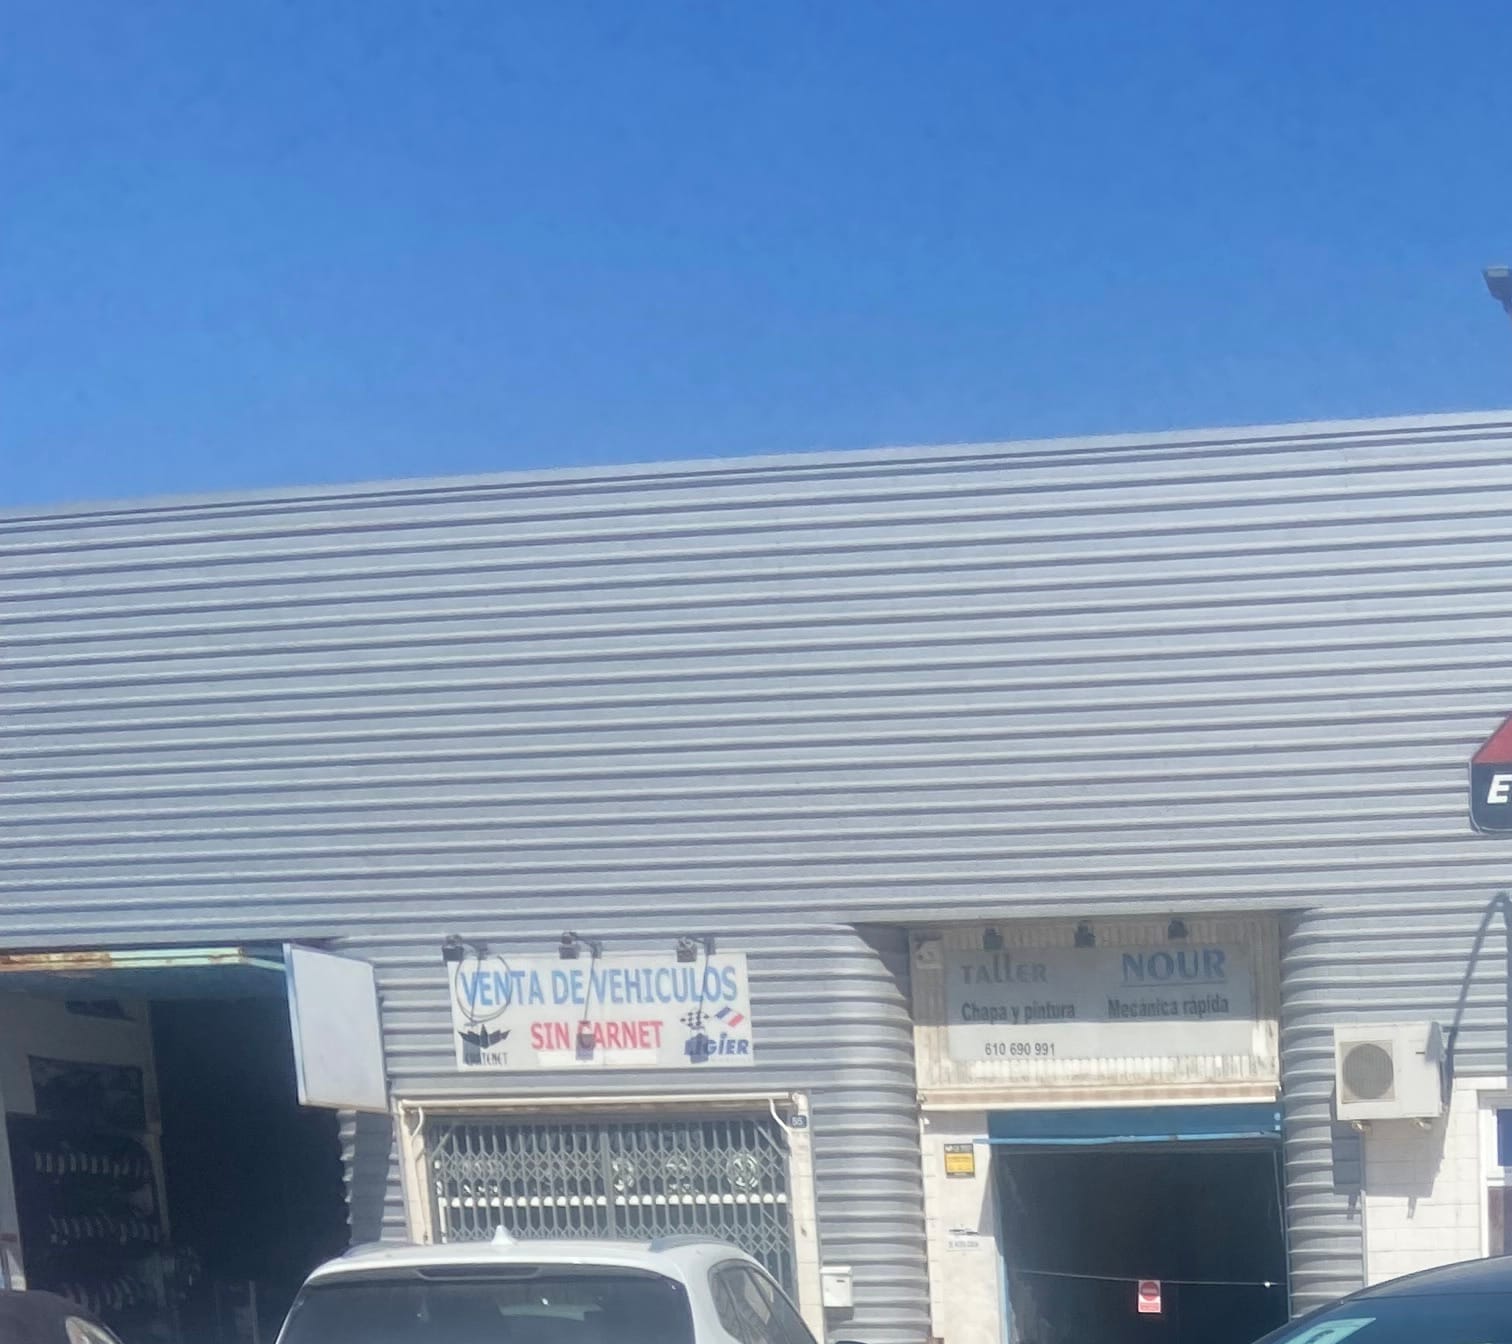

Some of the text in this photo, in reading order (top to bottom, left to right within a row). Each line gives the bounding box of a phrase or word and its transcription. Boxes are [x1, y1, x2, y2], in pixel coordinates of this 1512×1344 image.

[1121, 949, 1227, 982] NOUR
[460, 965, 738, 1006] VENTA DE VEHICULOS
[961, 1002, 1008, 1025] Chapa
[1024, 1000, 1076, 1024] pintura
[530, 1020, 664, 1050] SIN CARNET
[984, 1042, 1056, 1056] 610 690 991
